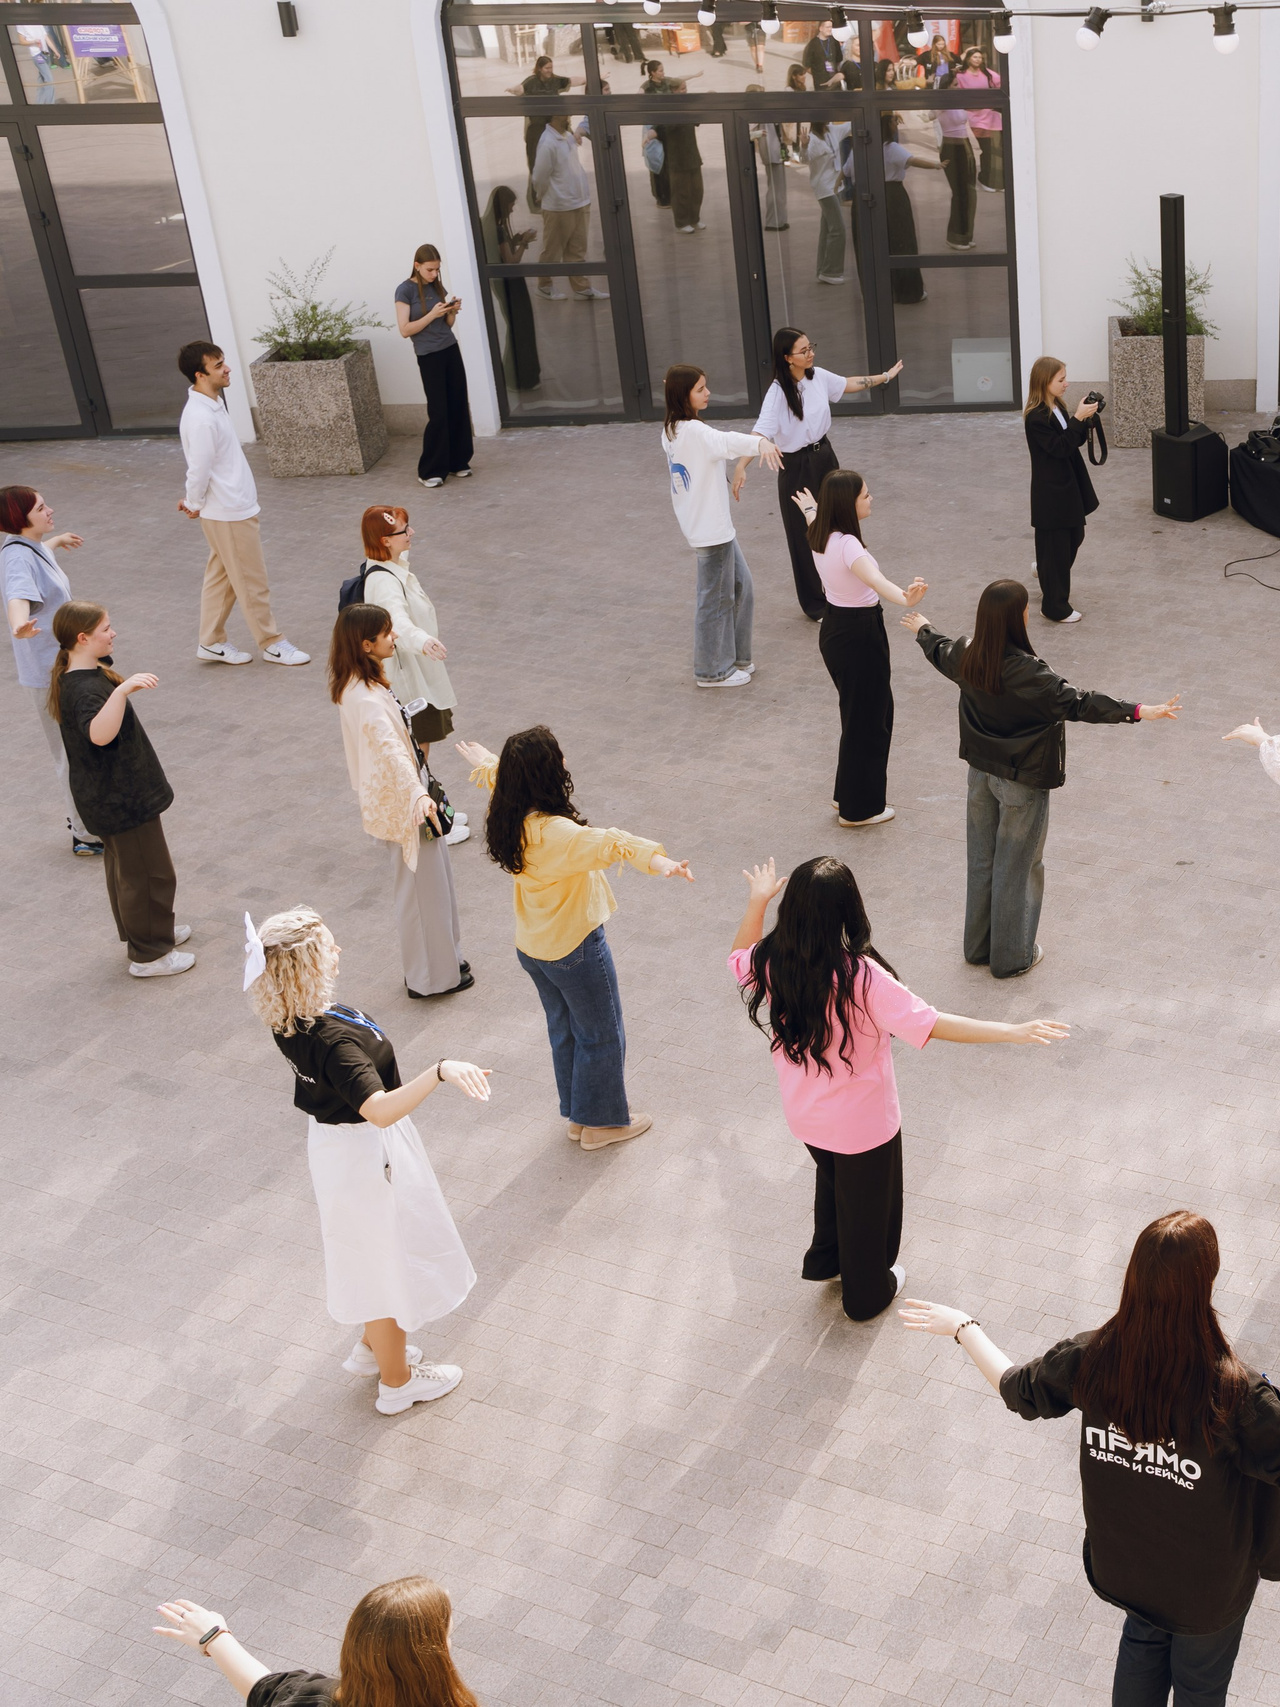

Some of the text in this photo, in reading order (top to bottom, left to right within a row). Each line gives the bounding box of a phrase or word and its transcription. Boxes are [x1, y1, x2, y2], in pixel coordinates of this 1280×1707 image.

[1085, 1426, 1202, 1480] ПРЯМО
[1089, 1448, 1195, 1491] ЗДЕСЬ И СЕЙЧАС
